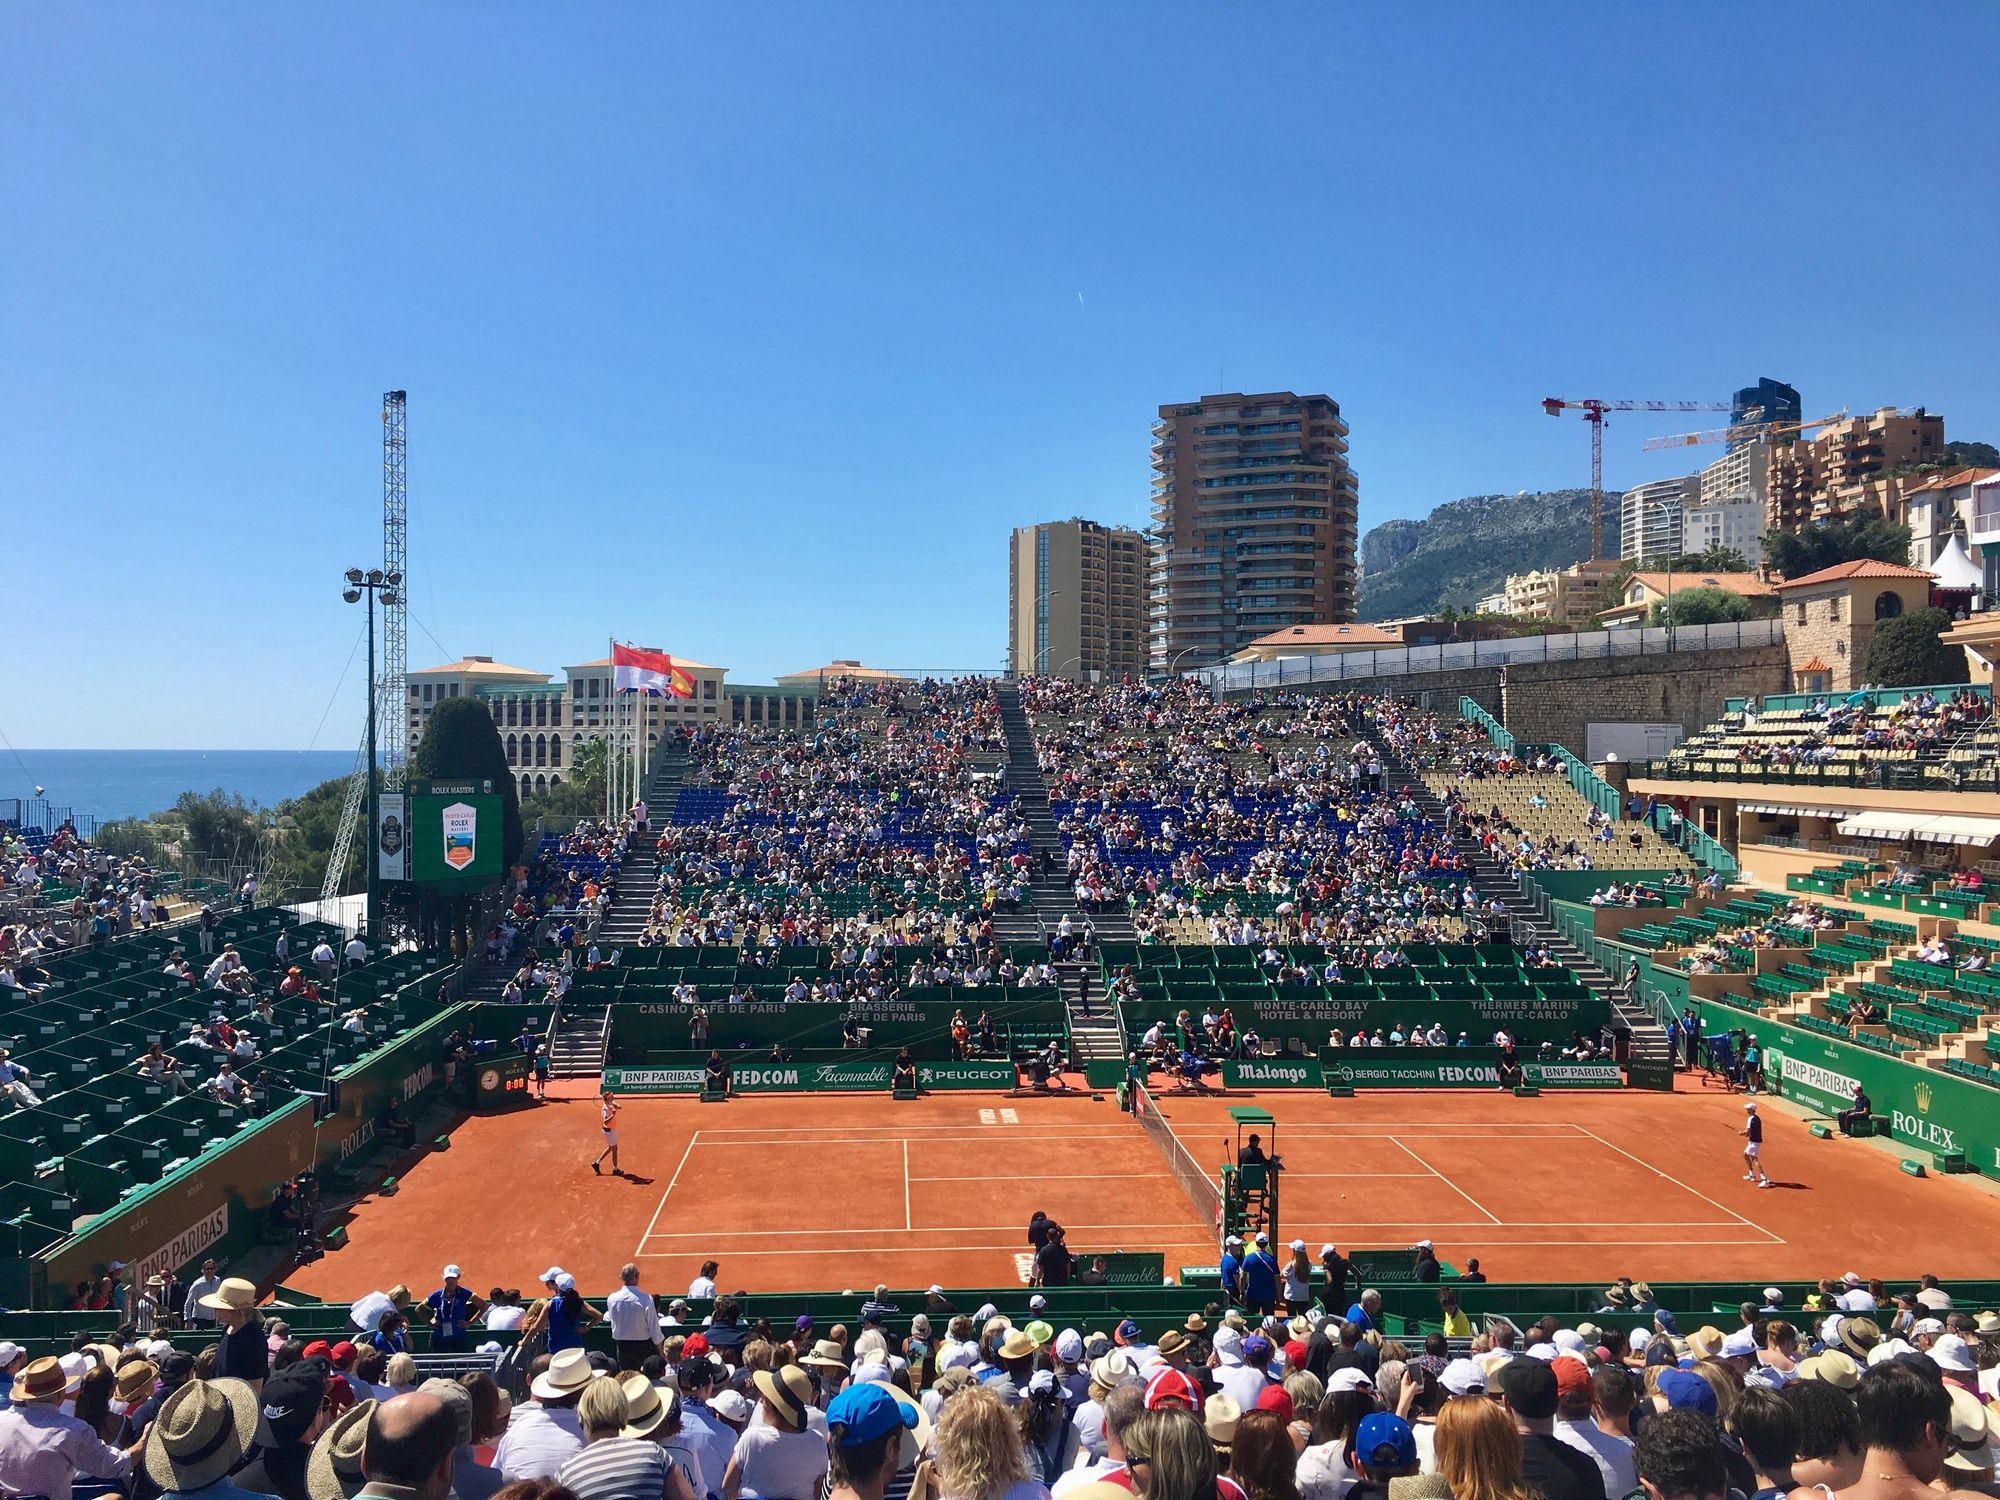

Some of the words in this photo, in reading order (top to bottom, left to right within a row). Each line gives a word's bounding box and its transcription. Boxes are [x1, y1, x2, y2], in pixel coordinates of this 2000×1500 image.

[431, 786, 449, 795] ROLEX
[450, 786, 475, 794] MASTERS
[451, 819, 469, 827] ROLEX
[639, 1004, 688, 1014] CASINO
[729, 1004, 746, 1014] DE
[750, 1004, 787, 1014] PARIS
[849, 1003, 916, 1012] BRASSERIE
[1253, 1001, 1341, 1010] MONTE-CARLO
[1345, 1001, 1369, 1010] BAY
[1471, 1001, 1528, 1010] THERMES
[1531, 1001, 1579, 1010] MARINS
[873, 1013, 890, 1022] DE
[892, 1013, 926, 1022] PARIS
[1259, 1010, 1300, 1020] HOTEL
[1303, 1010, 1312, 1020] &
[1315, 1010, 1364, 1020] RESORT
[1481, 1010, 1569, 1020] MONTE-CARLO
[1824, 1049, 1839, 1059] ROLEX
[505, 1067, 525, 1075] ROLEX
[1632, 1063, 1669, 1072] PEUGEOT
[625, 1071, 649, 1083] BNP
[651, 1071, 700, 1083] PARIBAS
[733, 1070, 799, 1086] FEDCOM
[811, 1065, 889, 1083] Façonnable
[935, 1070, 1012, 1080] PEUGEOT
[1237, 1063, 1307, 1084] Malongo
[1355, 1069, 1390, 1079] SERGIO
[1391, 1069, 1436, 1079] TACCHINI
[1438, 1066, 1499, 1082] FEDCOM
[1545, 1068, 1568, 1077] BNP
[1570, 1068, 1617, 1078] PARIBAS
[1785, 1058, 1807, 1080] BNP
[1809, 1067, 1856, 1098] PARIBAS
[403, 1062, 433, 1102] FEDCOM
[505, 1077, 524, 1091] 0:00
[1796, 1092, 1806, 1101] BNP
[1805, 1095, 1824, 1109] PARIBAS
[1892, 1109, 1954, 1150] ROLEX
[340, 1118, 376, 1161] ROLEX
[141, 1248, 169, 1290] BNP
[172, 1210, 223, 1268] PARIBAS
[264, 1404, 285, 1417] NIKE
